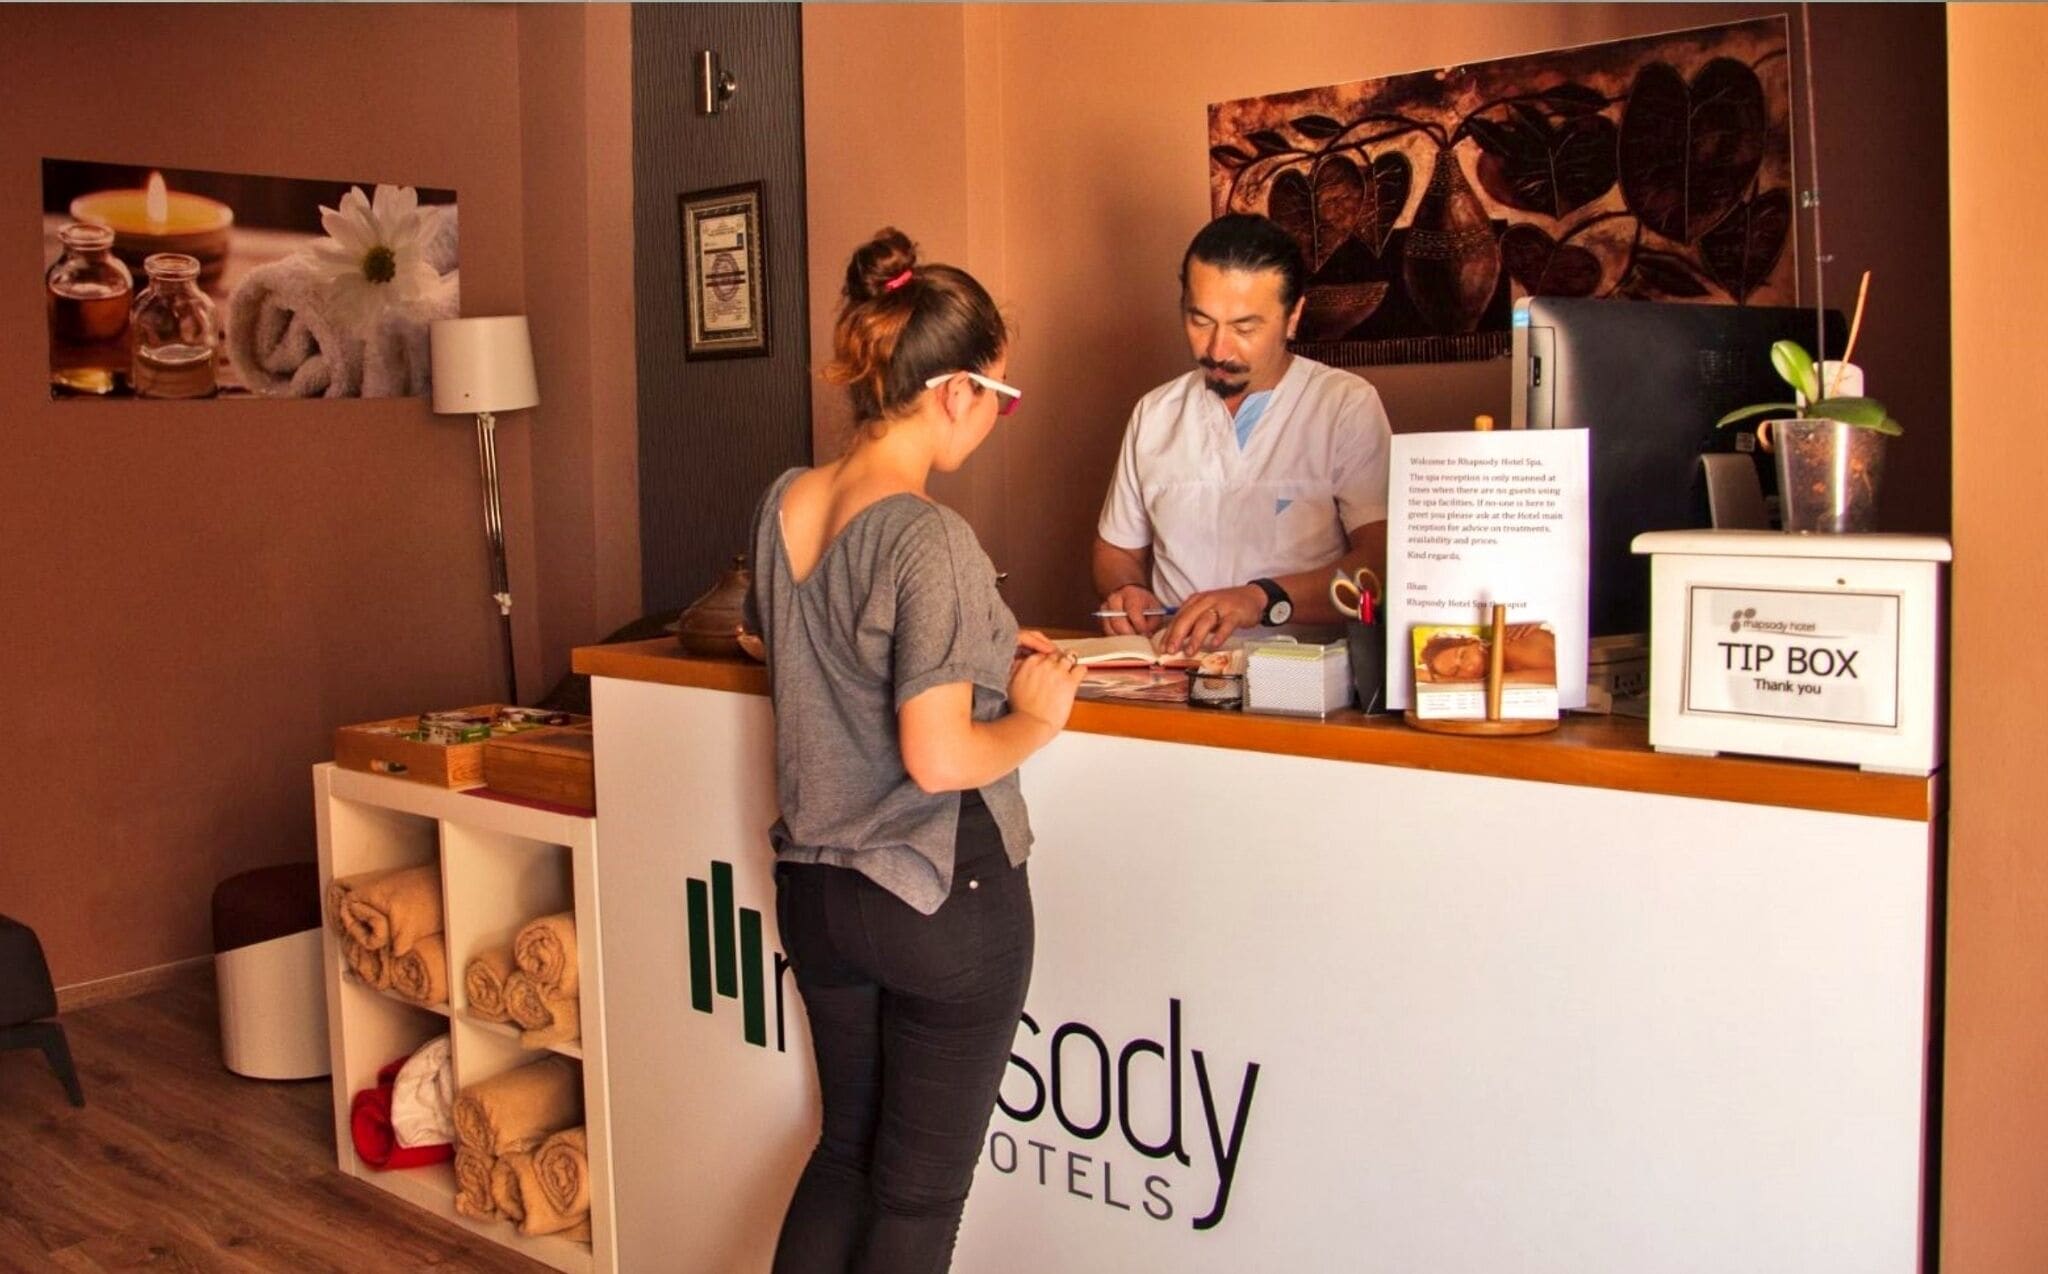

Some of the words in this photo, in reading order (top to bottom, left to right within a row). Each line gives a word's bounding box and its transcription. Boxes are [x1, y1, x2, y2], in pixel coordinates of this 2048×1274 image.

[1410, 457, 1446, 466] Welcome
[1446, 457, 1456, 466] to
[1458, 457, 1498, 468] Rhapsody
[1500, 457, 1524, 466] Hotel
[1410, 474, 1424, 482] The
[1424, 476, 1440, 484] spa
[1440, 474, 1480, 484] reception
[1482, 474, 1490, 482] is
[1490, 474, 1510, 484] only
[1512, 474, 1546, 482] manned
[1548, 474, 1556, 482] at
[1456, 487, 1478, 495] there
[1508, 487, 1536, 497] guests
[1538, 487, 1562, 497] using
[1408, 499, 1422, 507] the
[1422, 501, 1438, 509] spa
[1516, 500, 1524, 508] is
[1524, 500, 1544, 508] here
[1546, 500, 1556, 508] to
[1408, 511, 1428, 521] greet
[1430, 513, 1446, 521] you
[1446, 511, 1474, 522] please
[1476, 511, 1490, 520] ask
[1490, 512, 1500, 520] at
[1502, 512, 1516, 520] the
[1516, 512, 1540, 520] Hotel
[1542, 512, 1564, 520] main
[1408, 524, 1446, 534] reception
[1448, 524, 1460, 532] for
[1462, 524, 1490, 532] advice
[1408, 536, 1452, 546] availability
[1452, 536, 1470, 545] and
[1406, 552, 1428, 560] Kind
[1406, 600, 1446, 609] Rhapsody
[1448, 600, 1470, 608] Hotel
[1472, 600, 1488, 610] Spa
[1790, 621, 1816, 632] hotel
[1718, 642, 1774, 671] TIP
[1788, 646, 1859, 679] BOX
[1754, 678, 1793, 692] Thank
[1798, 682, 1822, 696] you
[988, 1129, 1176, 1221] OTELS
